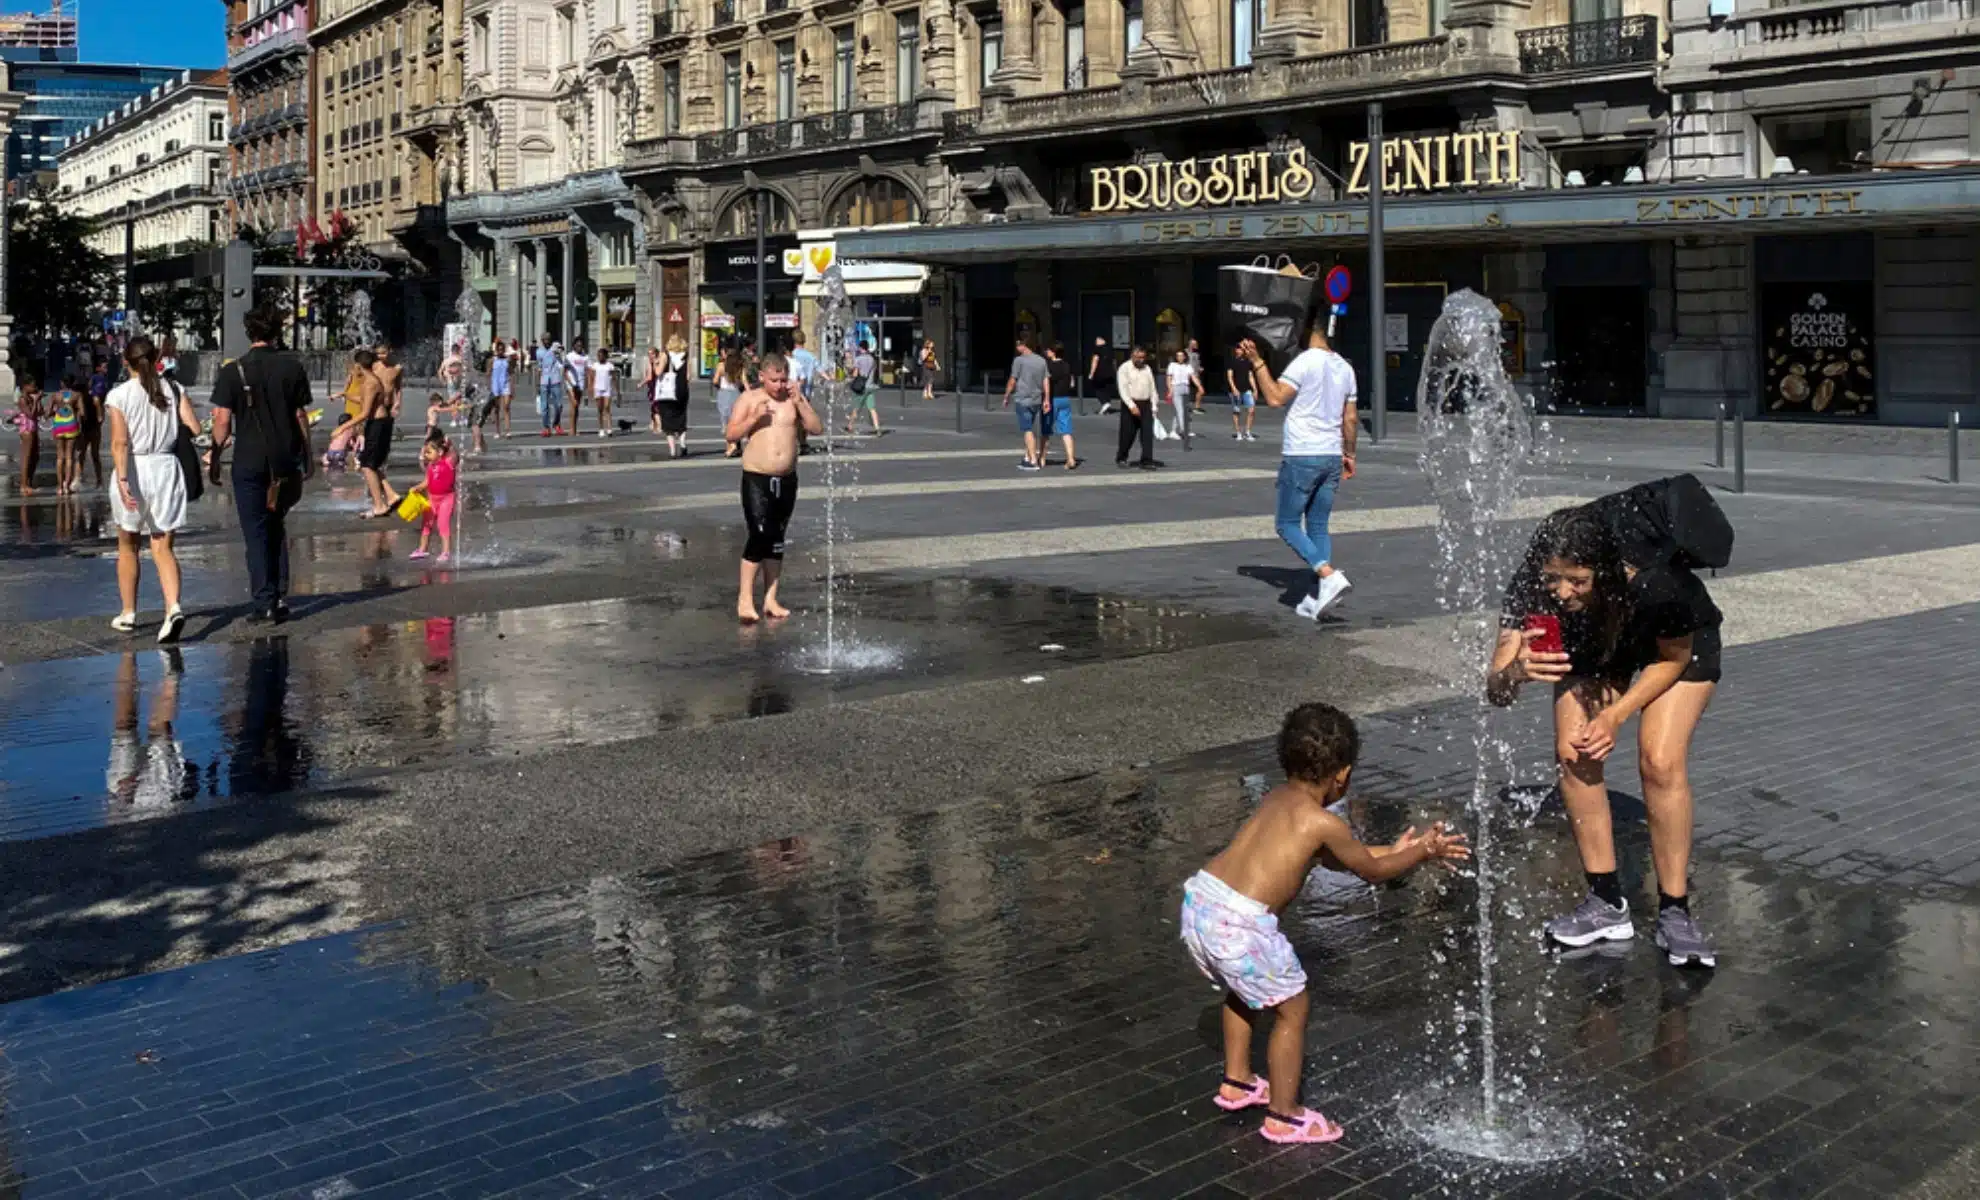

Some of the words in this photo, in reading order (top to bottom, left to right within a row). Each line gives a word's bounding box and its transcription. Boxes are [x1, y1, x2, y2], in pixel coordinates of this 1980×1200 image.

[1090, 145, 1315, 212] BRUSSELS
[1347, 129, 1523, 194] ZENITH
[1262, 211, 1370, 237] ZENITH
[1636, 190, 1864, 222] ZENITH
[752, 254, 776, 264] LND
[1790, 313, 1846, 324] GOLDEN
[1791, 324, 1846, 335] PALACE
[1791, 336, 1848, 347] CASINO
